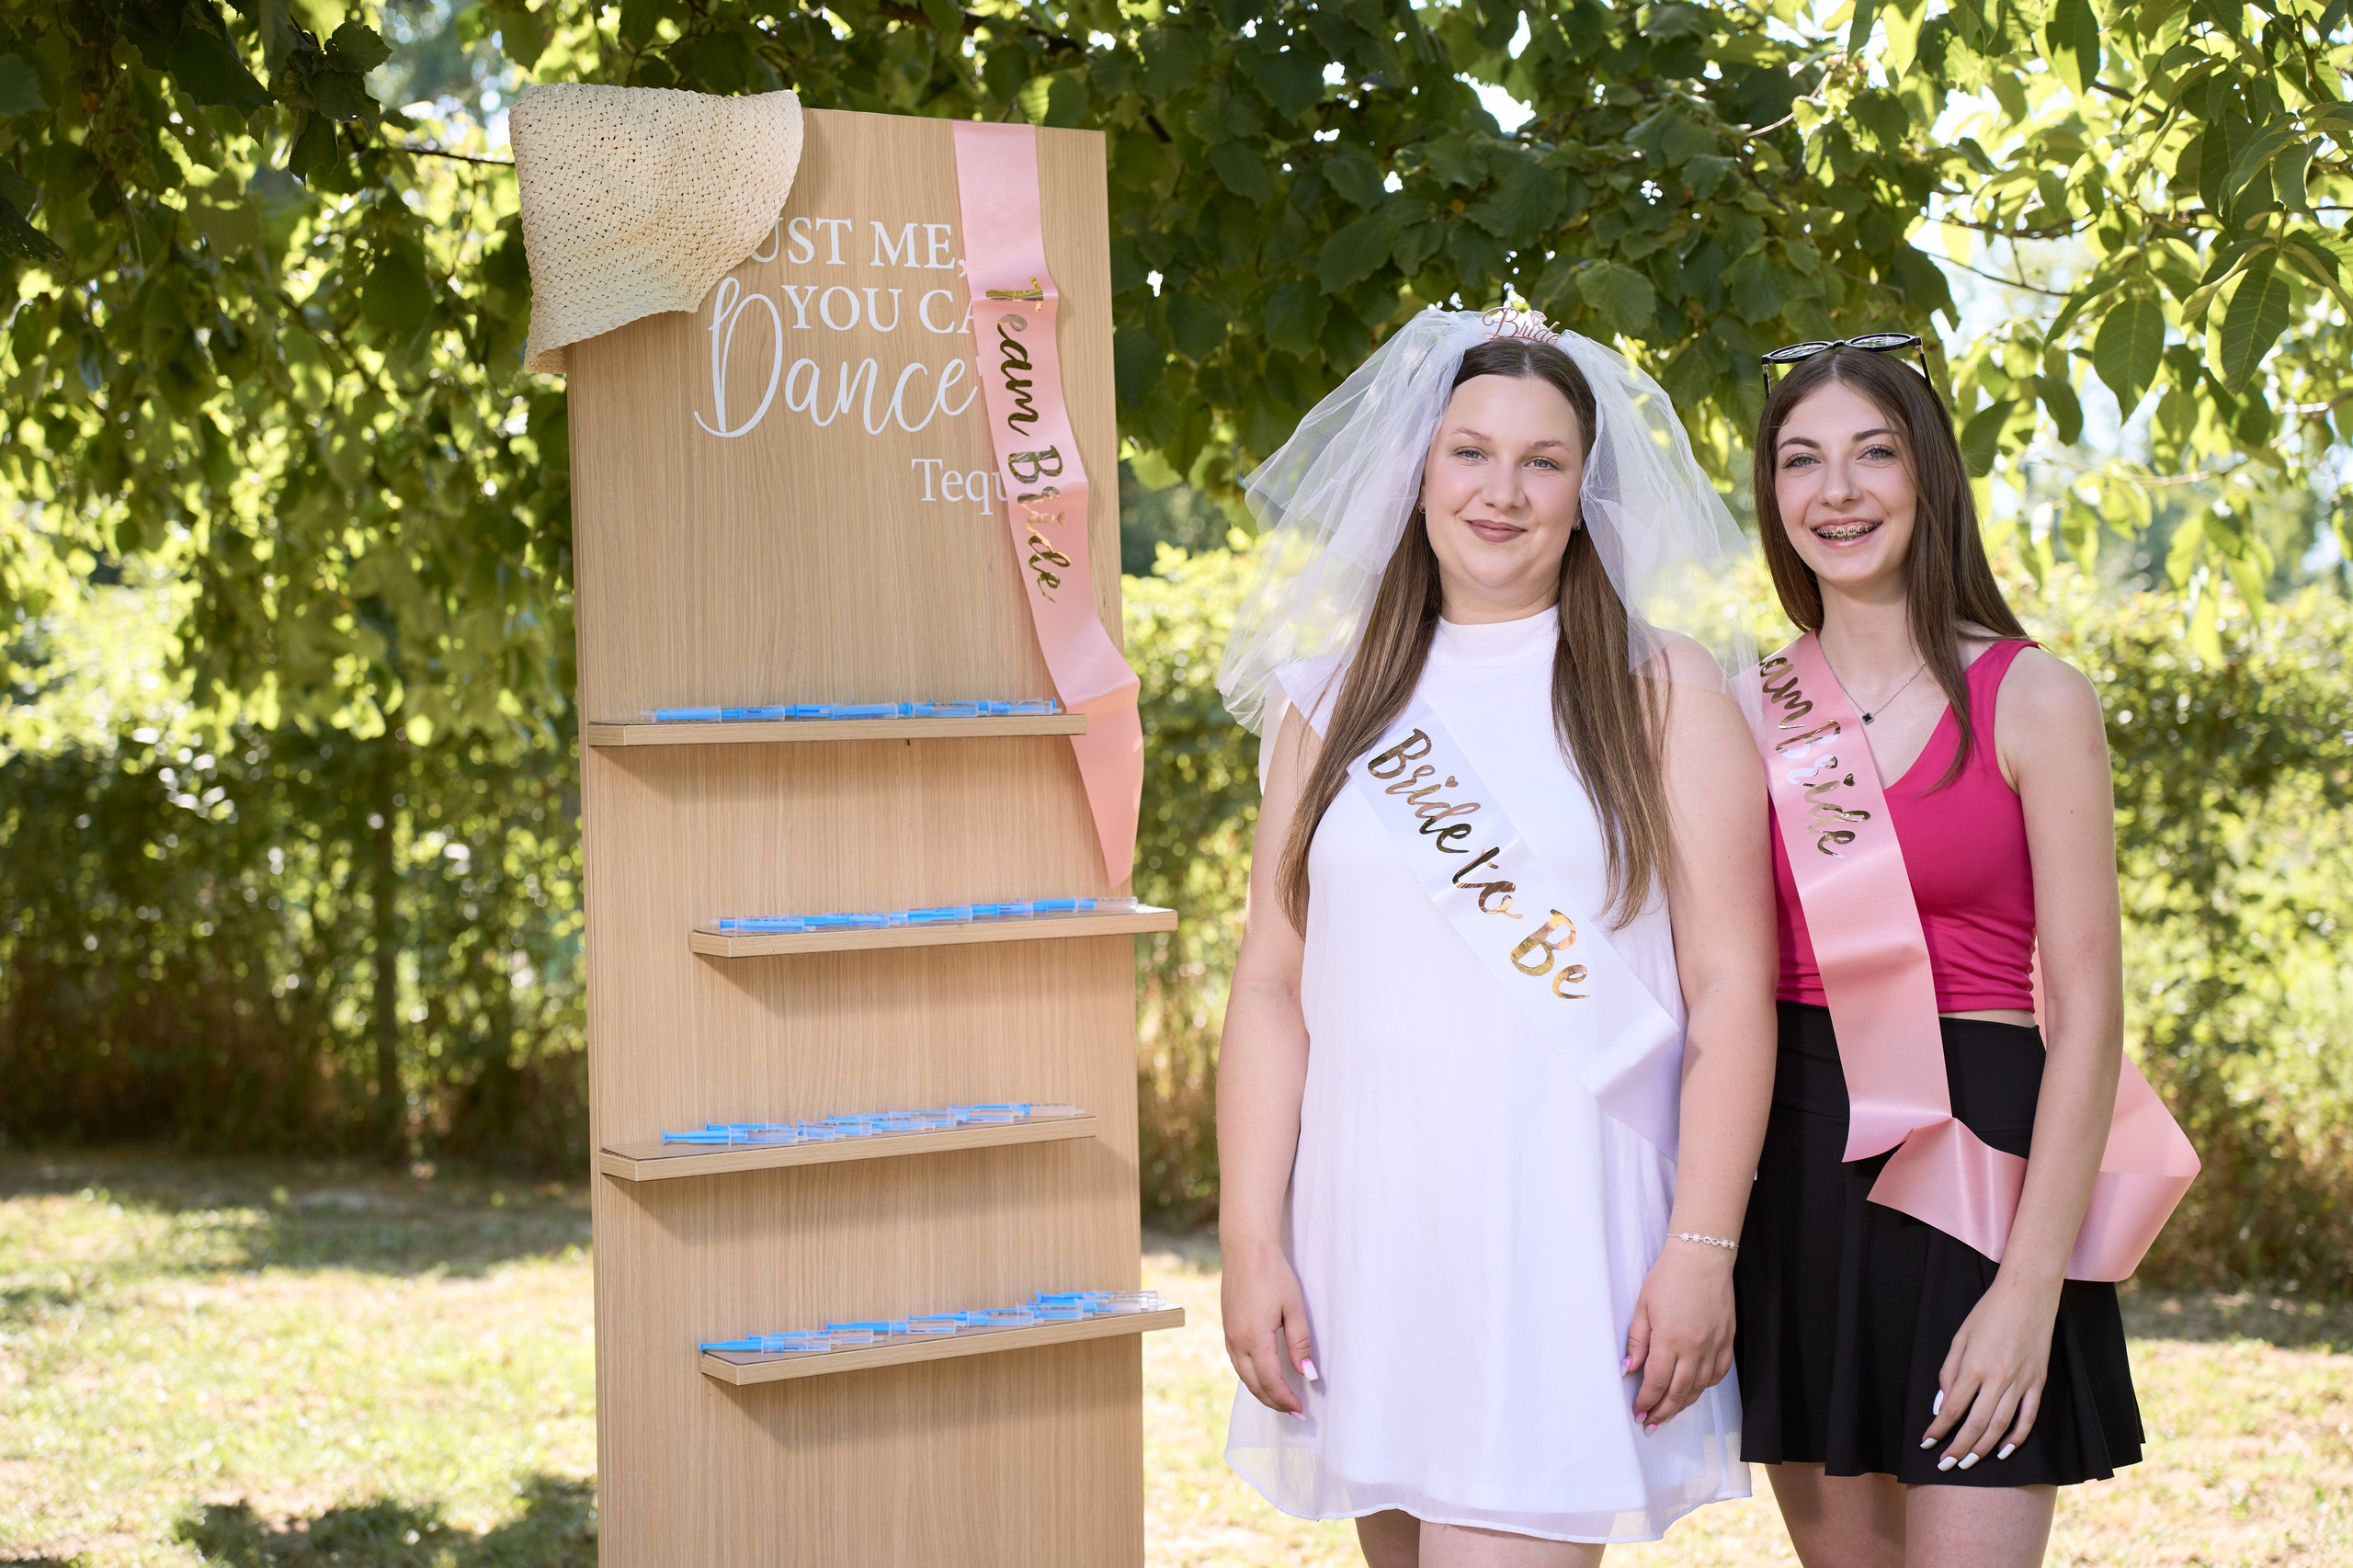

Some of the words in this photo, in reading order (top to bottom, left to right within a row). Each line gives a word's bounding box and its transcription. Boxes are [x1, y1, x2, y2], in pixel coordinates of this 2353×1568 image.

[749, 216, 854, 266] UST
[869, 221, 969, 278] ME,
[780, 284, 904, 333] YOU
[693, 276, 979, 438] Dance
[984, 276, 1044, 437] Team
[1482, 305, 1561, 347] Bride
[1006, 444, 1072, 604] Bride
[1757, 656, 1813, 730] am
[1775, 719, 1871, 859] Bride
[1367, 727, 1482, 854] Bride
[1451, 846, 1524, 920] to
[1509, 908, 1590, 1000] Be
